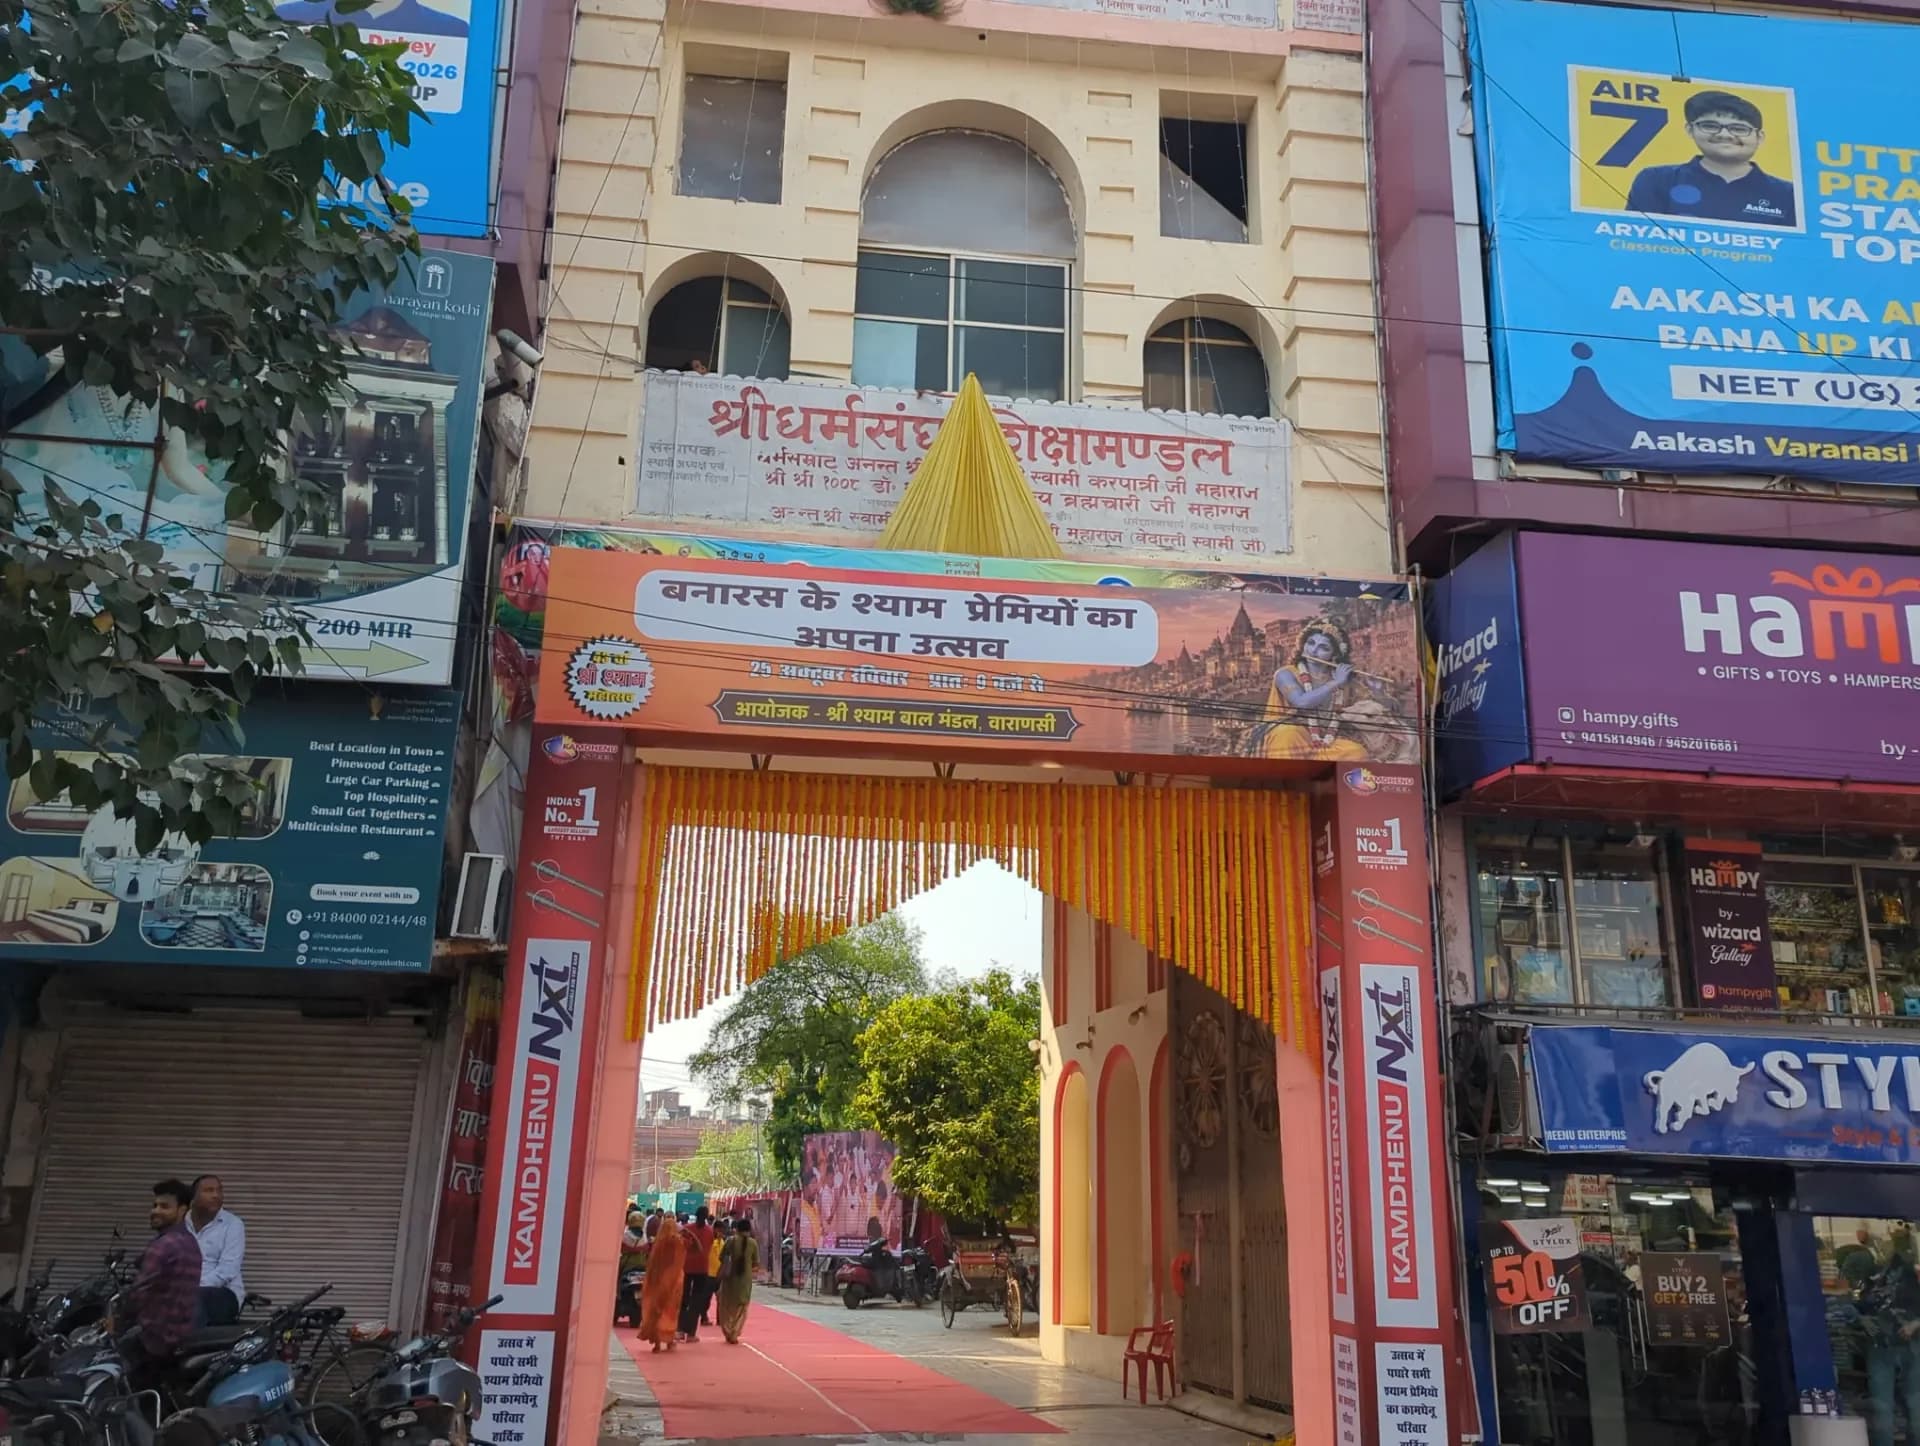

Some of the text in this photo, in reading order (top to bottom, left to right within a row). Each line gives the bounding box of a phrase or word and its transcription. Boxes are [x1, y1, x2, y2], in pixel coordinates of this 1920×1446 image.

[404, 62, 457, 79] 2026
[1592, 79, 1660, 103] AIR
[1590, 100, 1668, 168] 7
[1816, 141, 1920, 174] UTT
[1744, 204, 1783, 215] Aakash
[1819, 202, 1920, 234] STA
[1595, 221, 1783, 250] ARYAN DUBEY
[1609, 239, 1773, 264] Classroom Program
[444, 300, 480, 317] kothi
[1610, 286, 1870, 323] AAKASH KA
[1658, 324, 1912, 361] BANA UP KI
[1699, 373, 1901, 405] NEET (UG)
[1630, 430, 1906, 463] Aakash Varanasi
[847, 457, 900, 474] अनन्त
[1030, 467, 1079, 488] स्वामी
[1088, 474, 1160, 495] करपात्री
[1166, 480, 1188, 496] जी
[1196, 482, 1260, 500] महाराज
[766, 468, 785, 487] श्री
[794, 470, 814, 489] श्री
[1150, 496, 1175, 515] जी
[659, 579, 1138, 629] बनारस के श्याम प्रेमियों का
[317, 619, 413, 638] 200 MTR
[794, 626, 1009, 660] अपना उत्सव
[600, 667, 648, 688] श्याम
[778, 662, 847, 687] अक्टूबर
[850, 663, 911, 687] रविवार
[1713, 665, 1920, 690] GIFTS TOYS HAMPERS
[735, 698, 810, 720] आयोजक
[826, 700, 848, 723] श्री
[853, 706, 895, 724] श्याम
[899, 709, 933, 727] बाल
[988, 712, 1057, 733] वाराणसी
[1583, 709, 1679, 729] hampy.gifts
[310, 741, 433, 757] Best Location in Town
[1880, 739, 1906, 760] by
[331, 758, 432, 774] Pinewood Cottage
[326, 774, 430, 790] Large Car Parking
[343, 791, 427, 805] Top Hospitality
[544, 786, 600, 827] No. 1
[546, 796, 581, 807] INDIA'S
[311, 805, 425, 821] Small Get Togethers
[287, 821, 424, 836] Multicuisine Restaurant
[1356, 827, 1389, 838] INDIA'S
[1357, 817, 1408, 857] No. 1
[305, 911, 327, 923] +91
[330, 912, 367, 924] 84000
[1718, 908, 1734, 922] by
[1702, 923, 1762, 943] wizard
[1710, 942, 1752, 968] Gallery
[513, 1074, 550, 1268] KAMDHENU
[1385, 1095, 1412, 1283] KAMDHENU
[1657, 1275, 1708, 1293] BUY 2
[1654, 1292, 1717, 1306] GET 2 FREE
[1519, 1298, 1570, 1326] OFF
[525, 1335, 536, 1349] में
[492, 1411, 525, 1424] परिवार
[1397, 1420, 1427, 1434] परिवार
